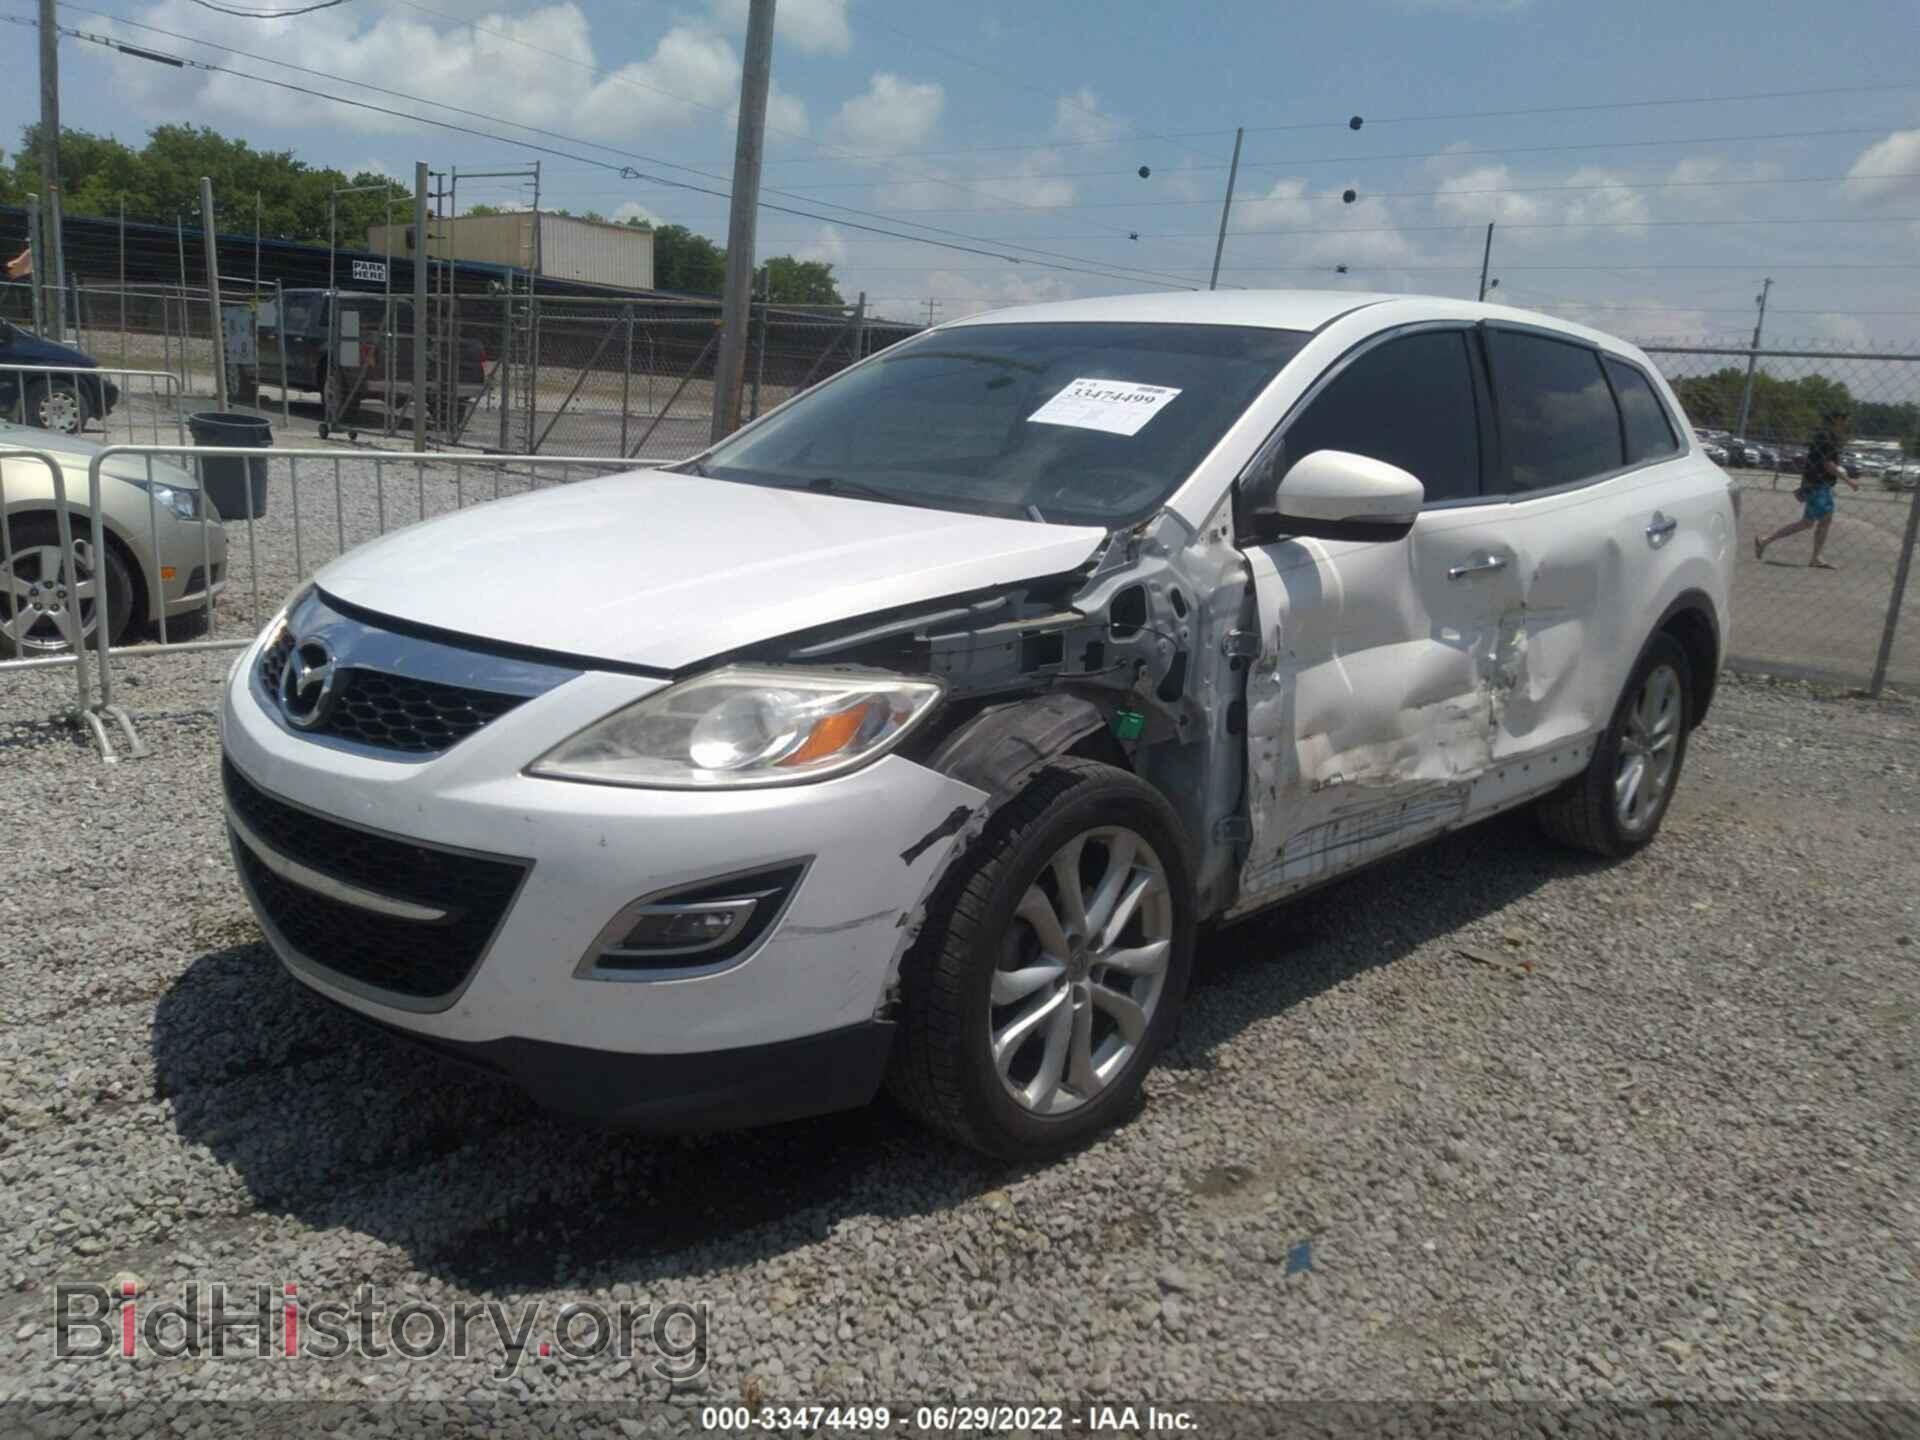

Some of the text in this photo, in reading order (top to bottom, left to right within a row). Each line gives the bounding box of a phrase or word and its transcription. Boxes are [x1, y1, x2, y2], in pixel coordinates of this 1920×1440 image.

[354, 262, 385, 272] PARK
[355, 271, 385, 281] HERE
[1073, 388, 1157, 404] 33474499
